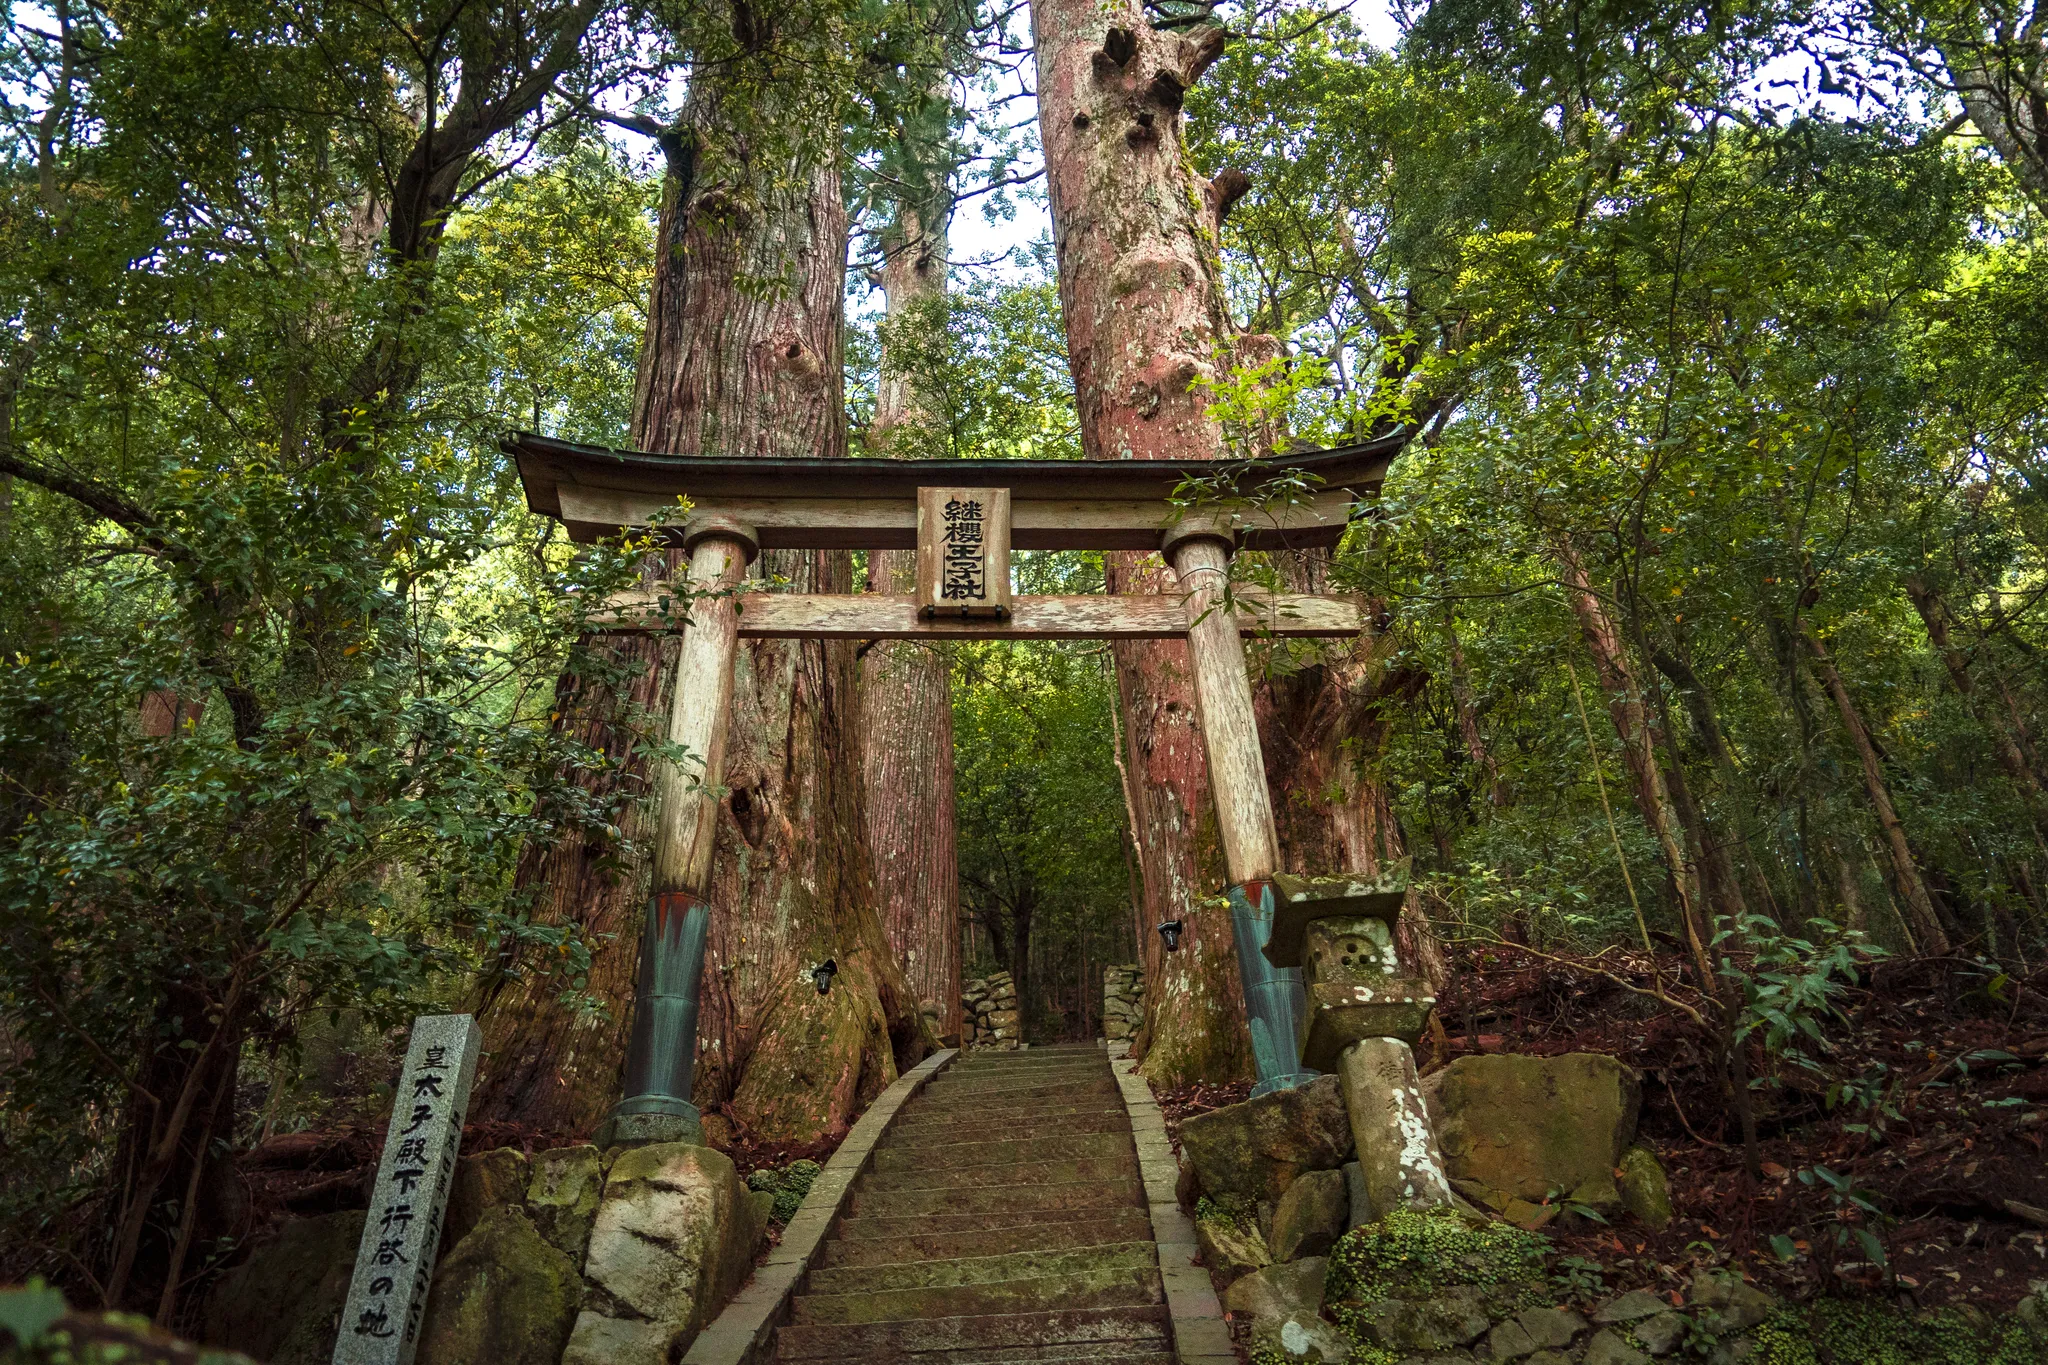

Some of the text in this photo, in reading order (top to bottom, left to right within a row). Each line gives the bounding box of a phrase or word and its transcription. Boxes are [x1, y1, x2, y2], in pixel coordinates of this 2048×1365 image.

[354, 1044, 449, 1338] 皇太子殿下行啓の地
